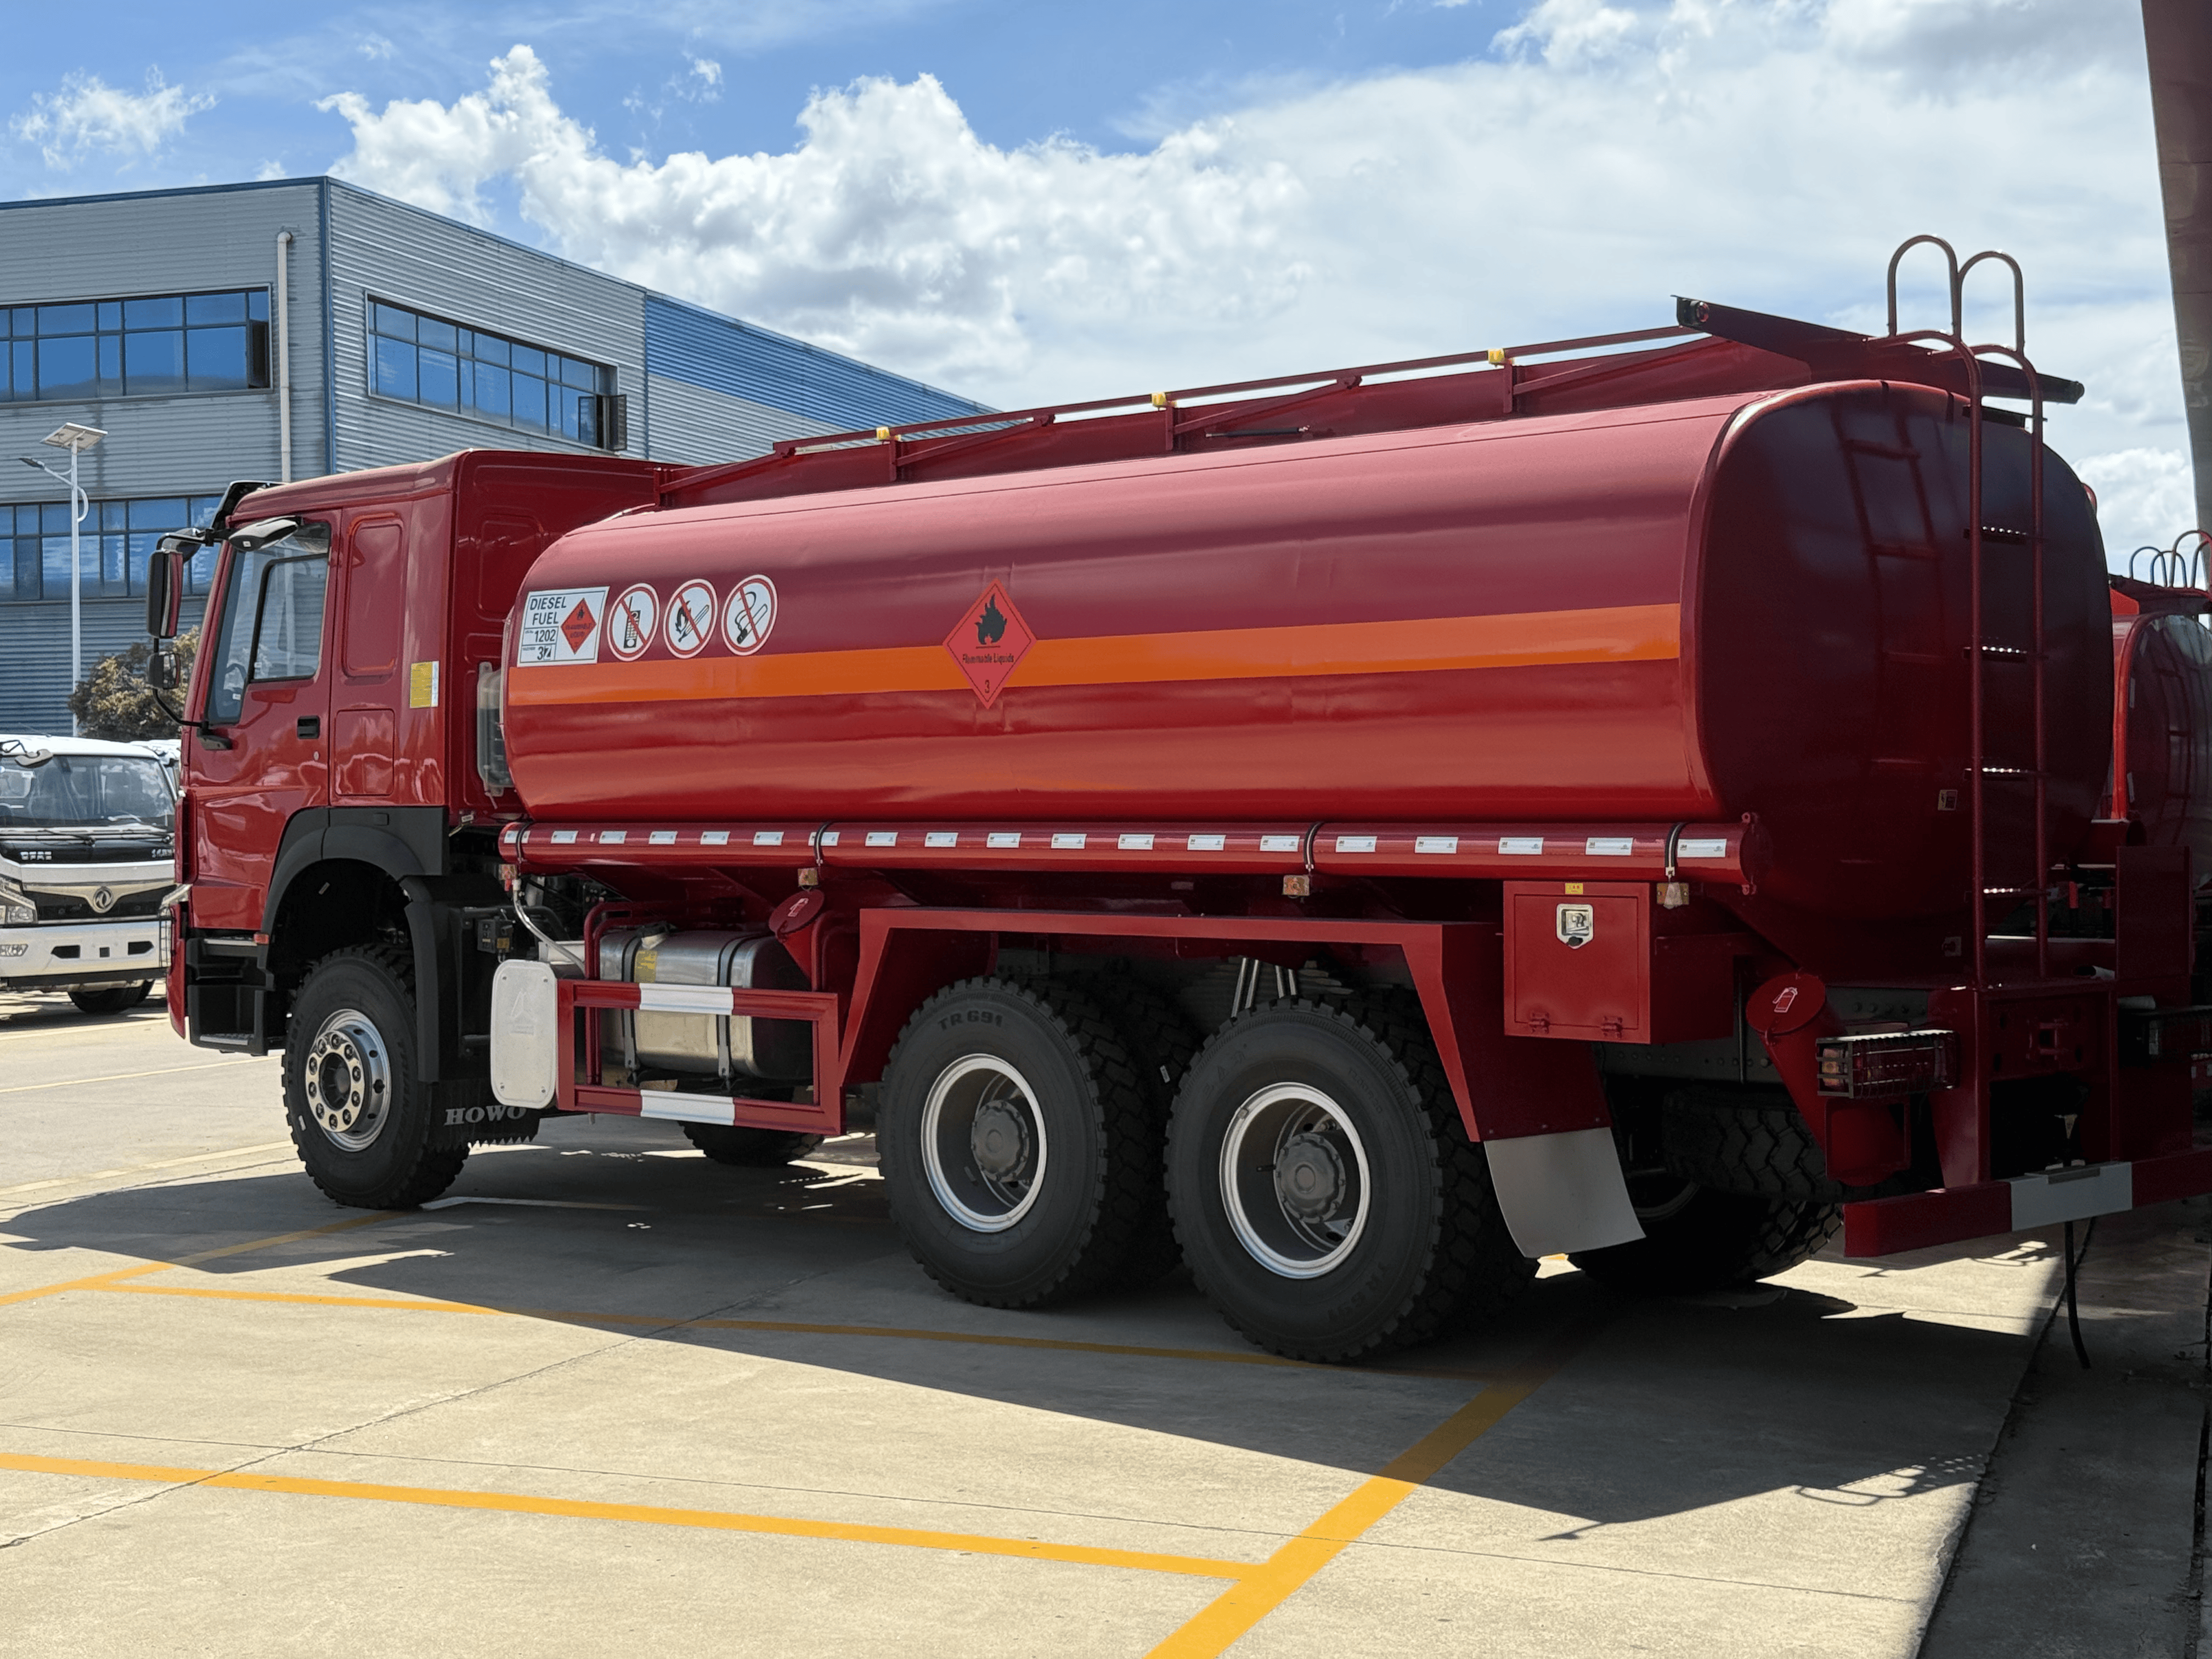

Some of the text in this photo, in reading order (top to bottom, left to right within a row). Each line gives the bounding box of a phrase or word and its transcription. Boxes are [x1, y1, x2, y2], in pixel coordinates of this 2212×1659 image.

[530, 596, 567, 611] DIESEL
[532, 612, 558, 625] FUEL
[534, 629, 556, 642] 1202
[985, 679, 990, 693] 3
[938, 1010, 1002, 1030] TR 691
[443, 1105, 527, 1126] HOWO
